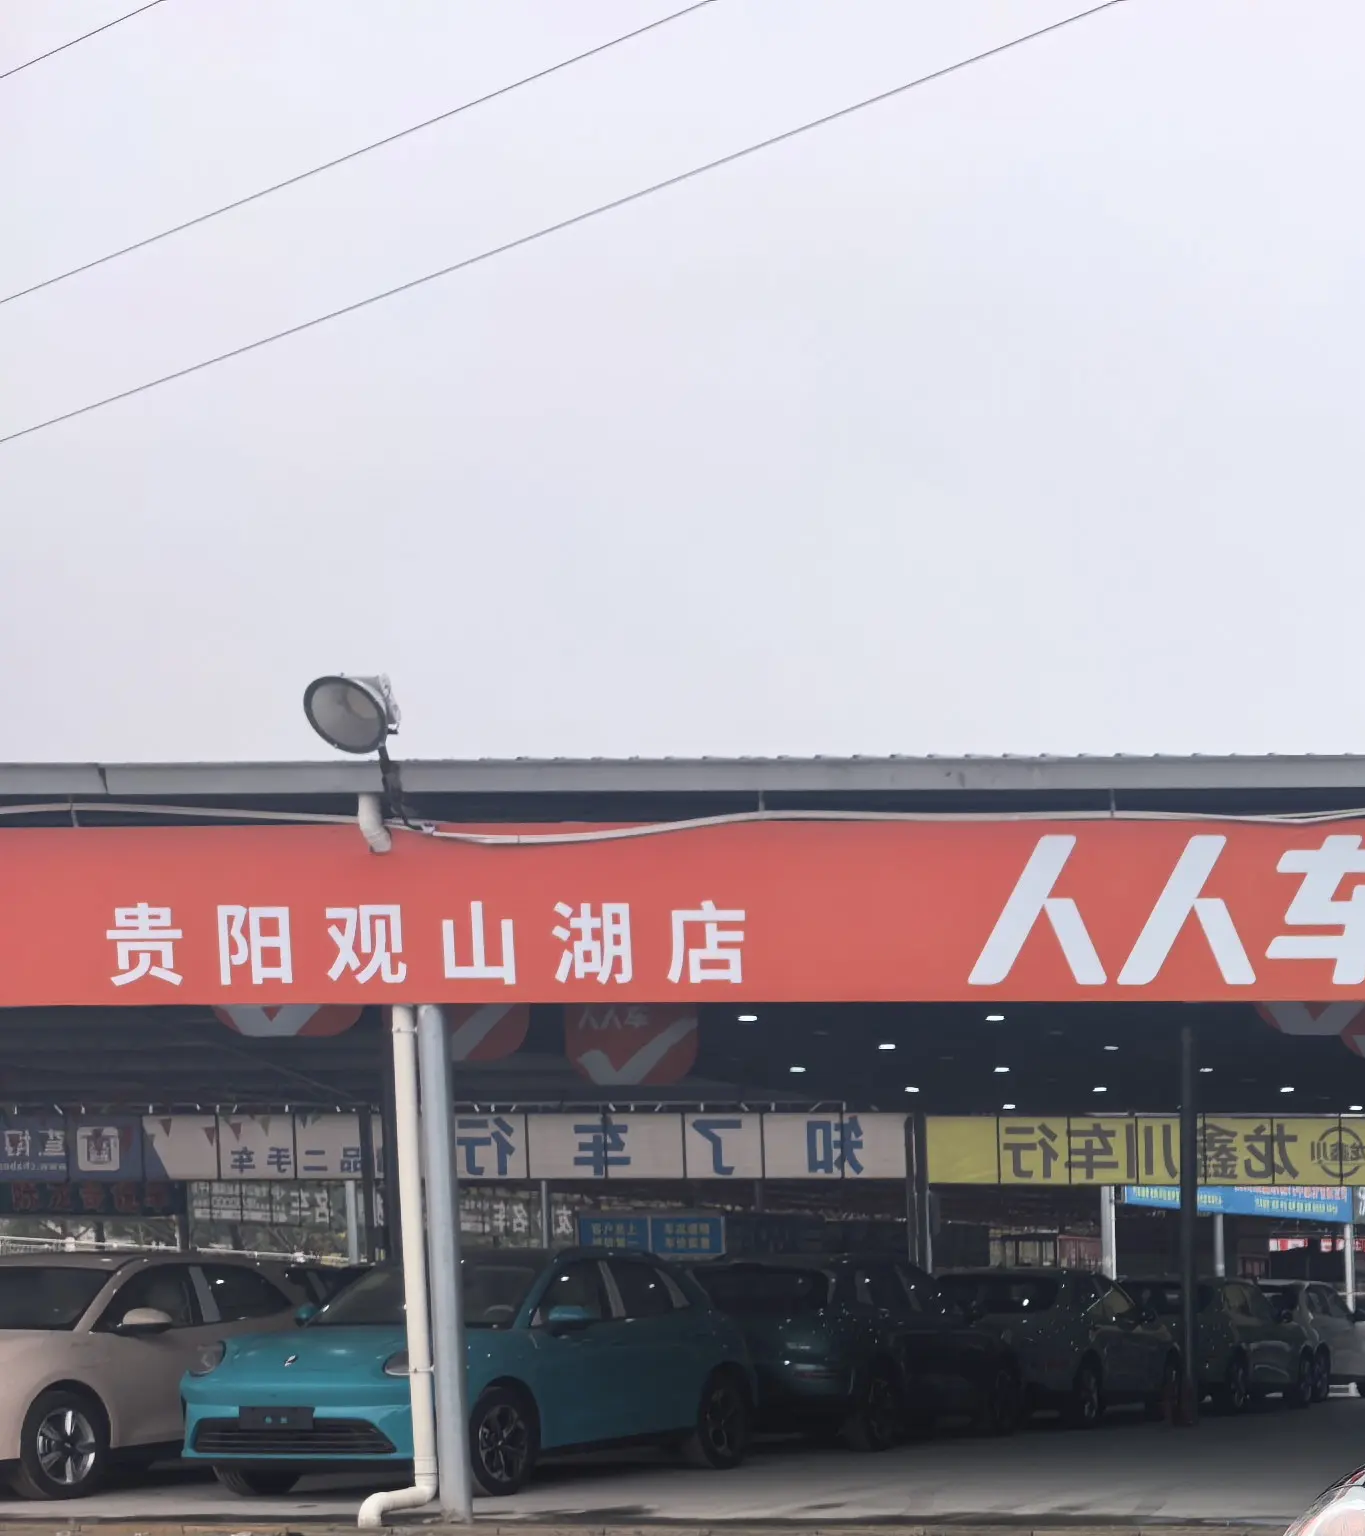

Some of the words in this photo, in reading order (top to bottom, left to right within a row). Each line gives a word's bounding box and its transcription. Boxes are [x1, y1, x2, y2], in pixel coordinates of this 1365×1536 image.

[105, 899, 746, 987] 贵阳观山湖店
